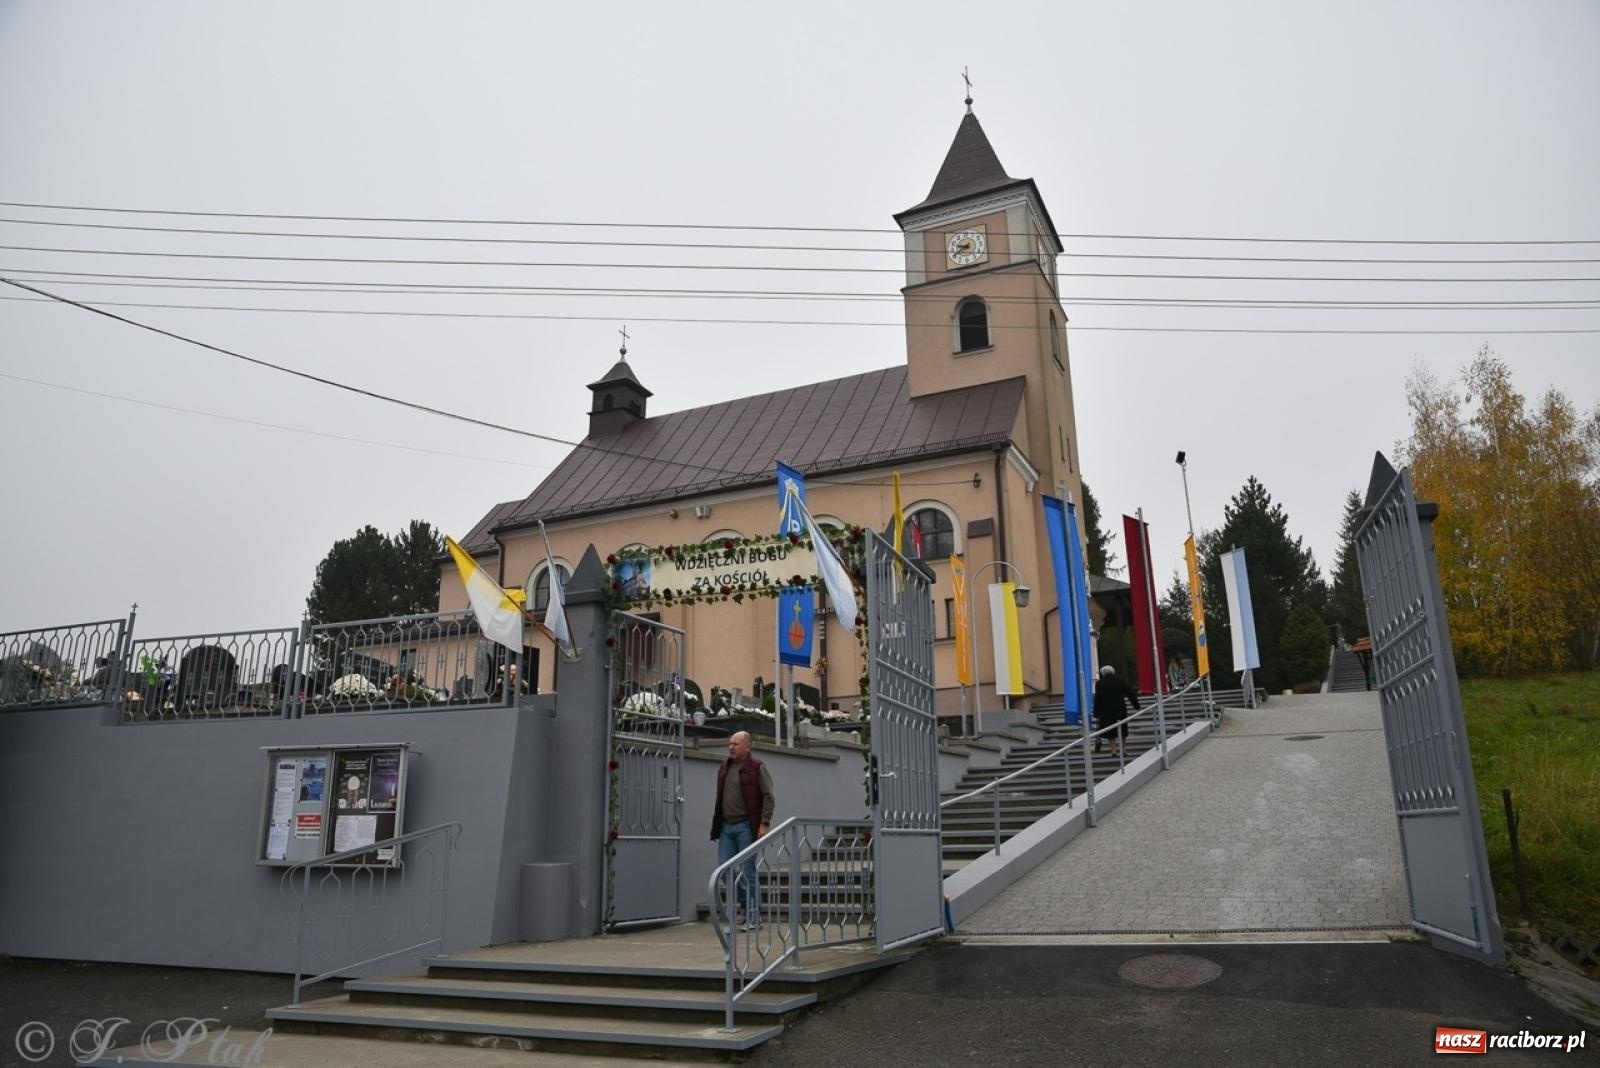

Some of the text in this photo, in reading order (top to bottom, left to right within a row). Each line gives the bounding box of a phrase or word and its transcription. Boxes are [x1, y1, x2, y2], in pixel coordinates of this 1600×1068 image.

[674, 549, 787, 570] WDZIĘCZNI BOGU
[694, 568, 769, 588] ZA KOŚCIÓŁ
